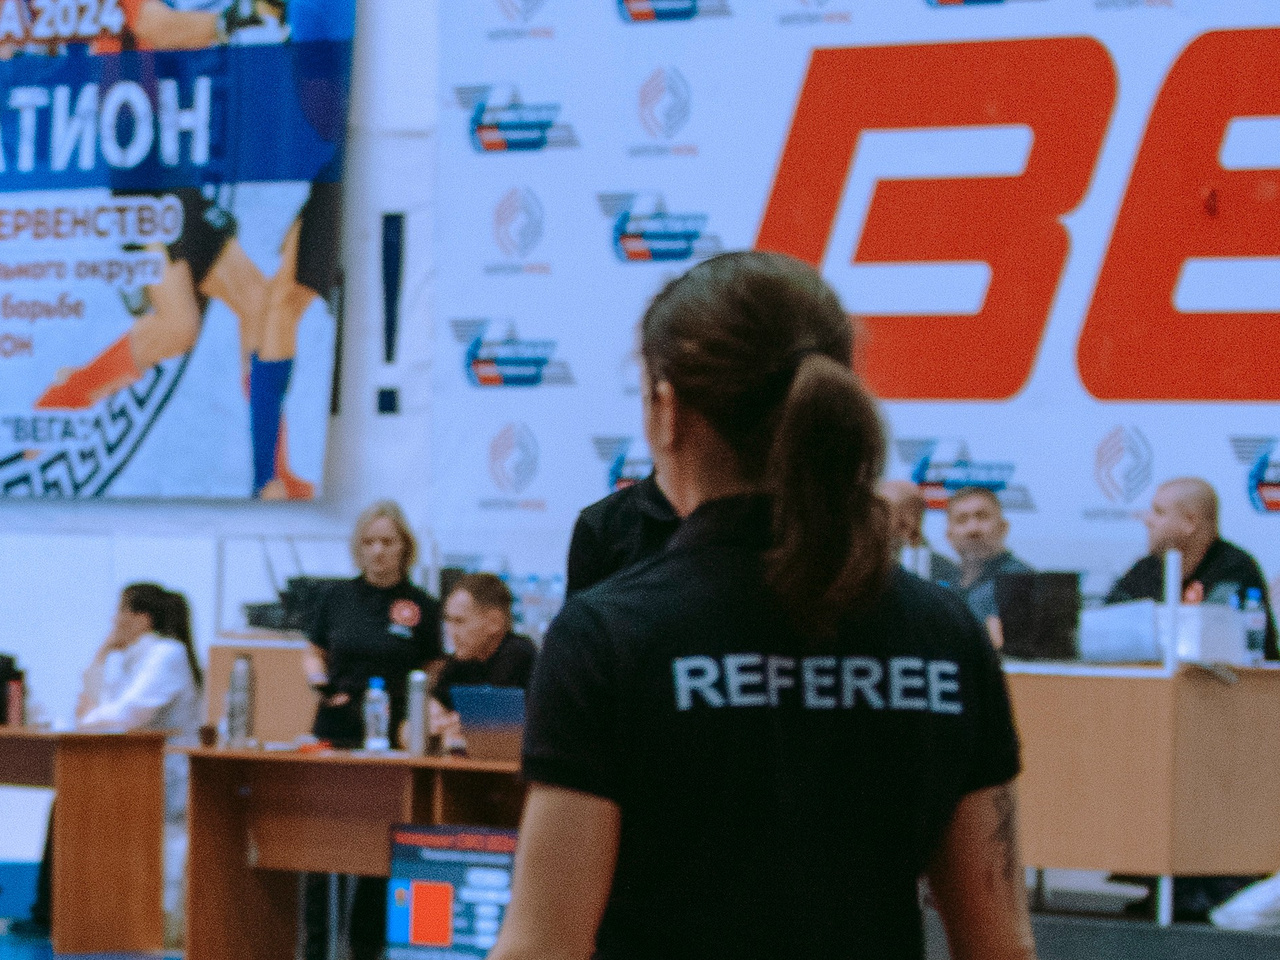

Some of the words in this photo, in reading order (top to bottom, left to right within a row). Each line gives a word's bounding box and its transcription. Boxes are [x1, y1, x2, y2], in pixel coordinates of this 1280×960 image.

[30, 0, 124, 37] 2024
[74, 254, 163, 287] округа
[672, 653, 963, 715] REFEREE
